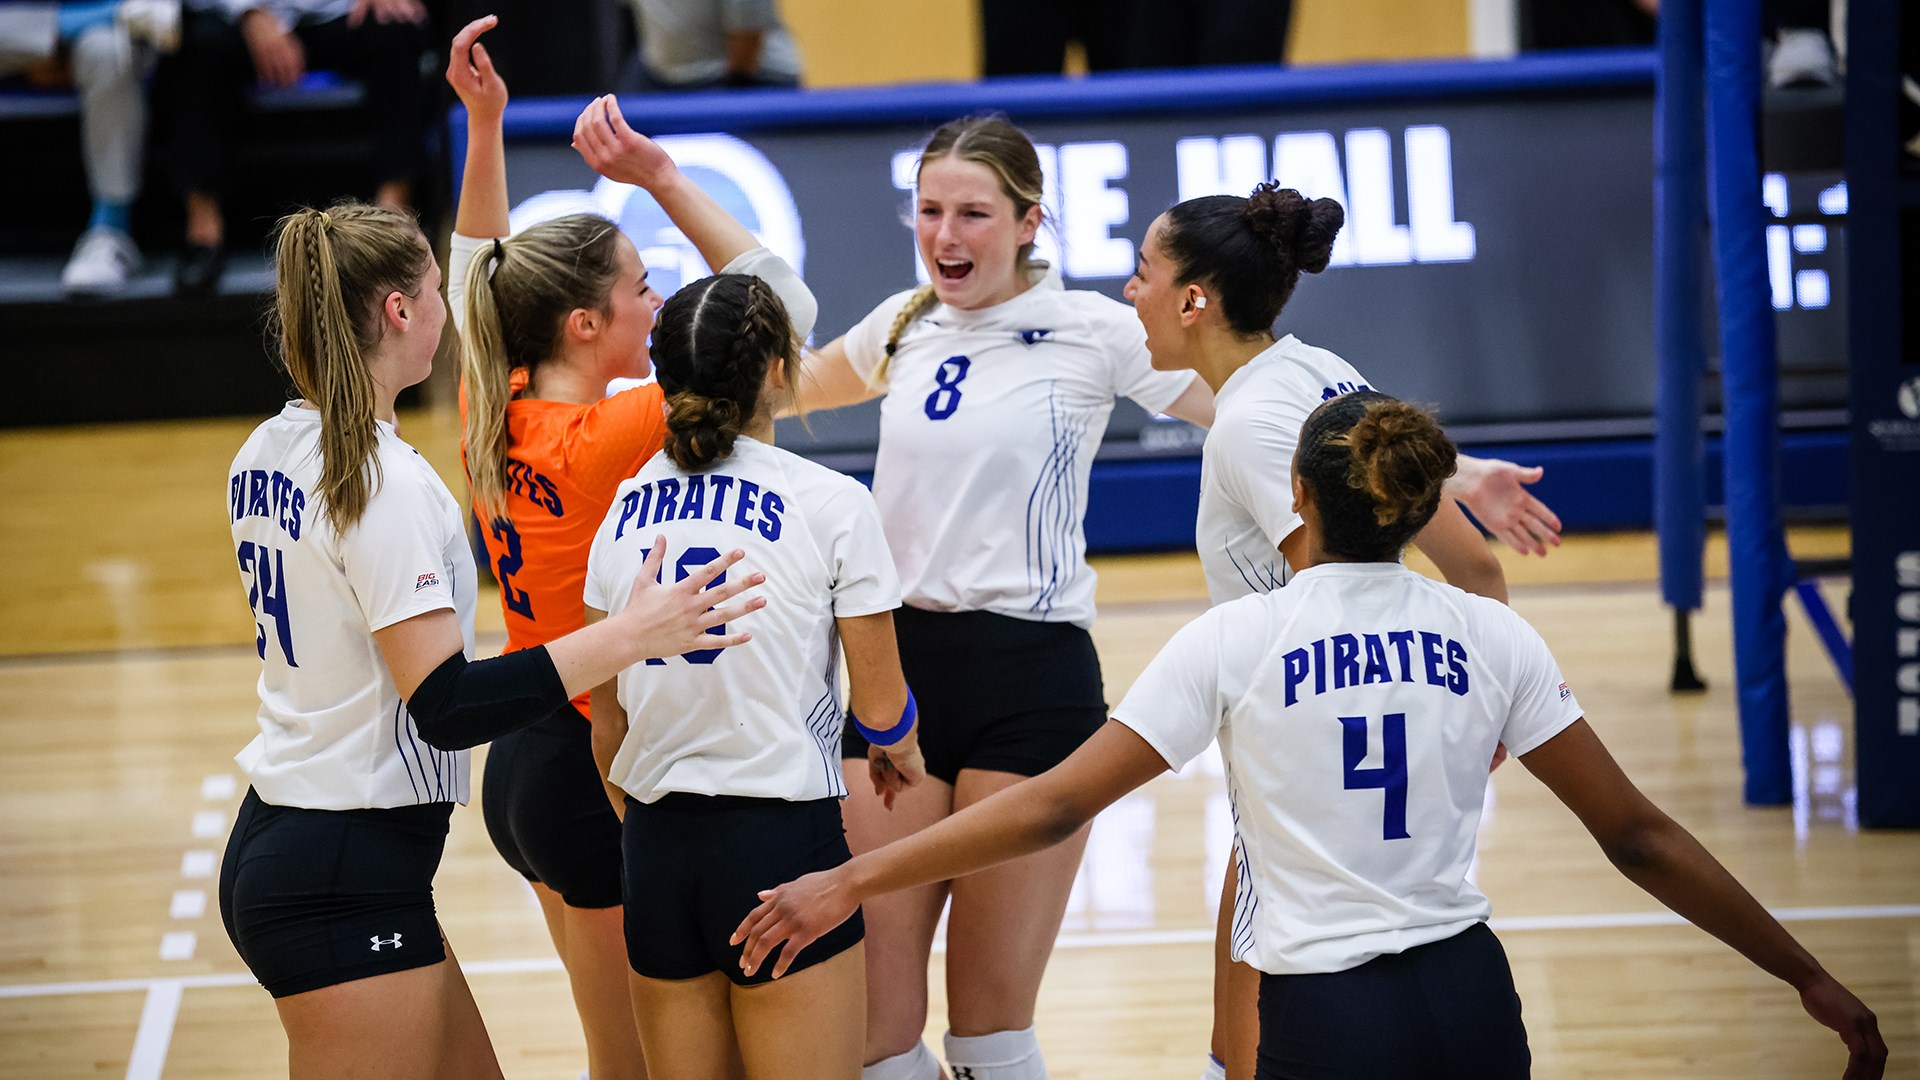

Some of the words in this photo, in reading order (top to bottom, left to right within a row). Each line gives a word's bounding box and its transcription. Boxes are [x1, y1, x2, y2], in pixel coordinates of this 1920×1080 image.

[925, 355, 971, 420] 8
[231, 469, 305, 542] PIRATES
[615, 474, 785, 542] PIRATES
[238, 540, 300, 668] 24
[417, 573, 435, 581] BIG
[1281, 630, 1469, 708] PIRATES
[1337, 713, 1412, 841] 4
